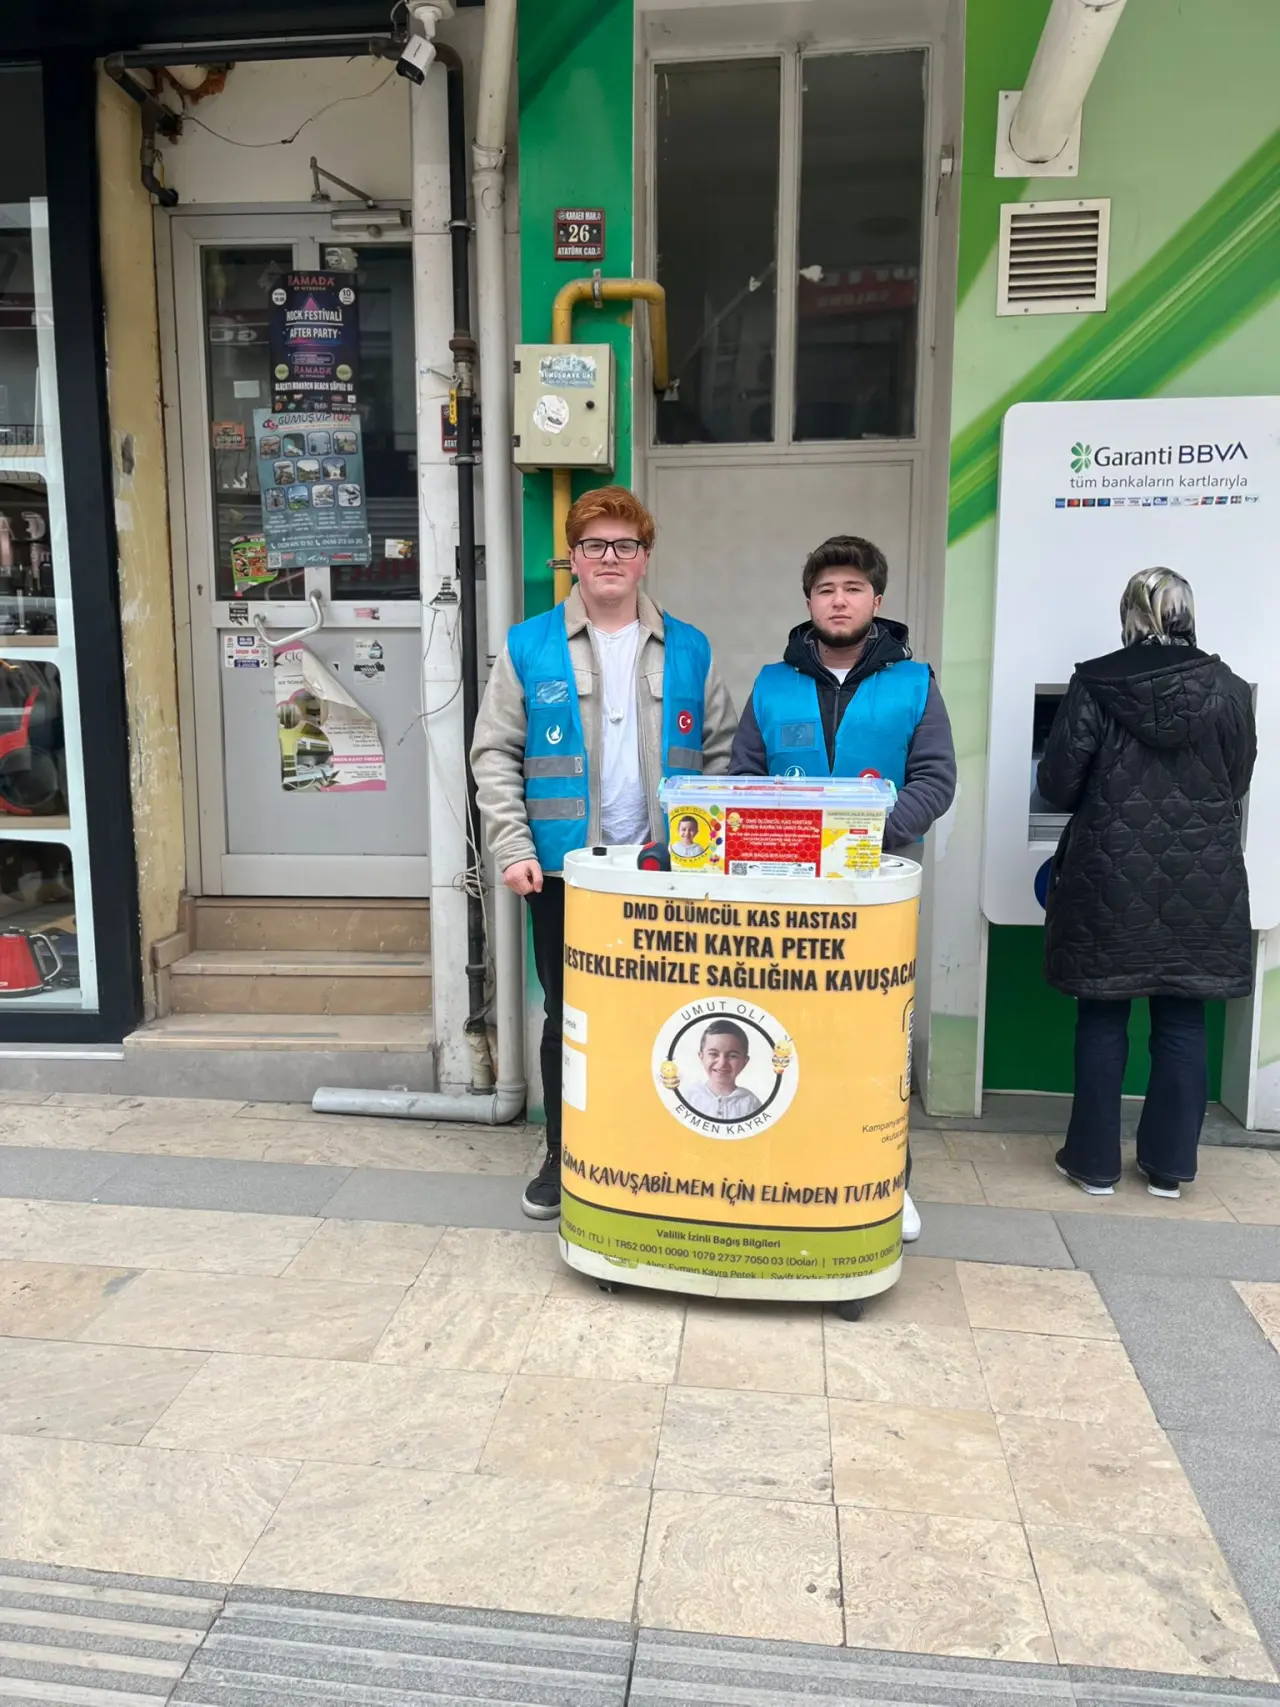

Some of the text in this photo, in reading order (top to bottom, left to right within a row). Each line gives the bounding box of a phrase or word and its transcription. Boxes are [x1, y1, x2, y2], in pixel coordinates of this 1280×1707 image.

[568, 224, 590, 243] 26
[557, 246, 583, 256] ATATÜRK
[287, 275, 336, 286] RAMADA
[286, 307, 342, 321] ROCK FESTİVALİ
[290, 328, 338, 339] AFTER PARTY
[1094, 441, 1249, 468] Garanti BBVA
[1070, 474, 1249, 490] tüm bankaların kartlarıyla
[623, 900, 858, 929] DMD ÖLÜMCÜL KAS HASTASI
[633, 928, 846, 960] EYMEN KAYRA PETEK
[706, 961, 818, 991] SAĞLIĞINA
[680, 1001, 766, 1023] UMUT OL!
[675, 1103, 772, 1135] EYMEN KAYRA
[589, 1164, 715, 1198] KAVUŞABİLMEM
[720, 1177, 755, 1206] İÇİN
[761, 1181, 838, 1205] ELİMDEN
[844, 1178, 891, 1204] TUTAR
[588, 1231, 605, 1245] (TL)
[615, 1239, 638, 1252] TR52
[639, 1244, 663, 1255] 0001
[665, 1247, 690, 1258] 0090
[692, 1250, 716, 1260] 1079
[717, 1253, 742, 1263] 2737
[744, 1255, 768, 1265] 7050
[770, 1256, 784, 1266] 03
[786, 1257, 818, 1267] (Dolar)
[831, 1257, 857, 1267] TR79
[858, 1251, 879, 1264] 0001
[656, 1229, 781, 1249] Valilik İzinli Bağış Bilgileri
